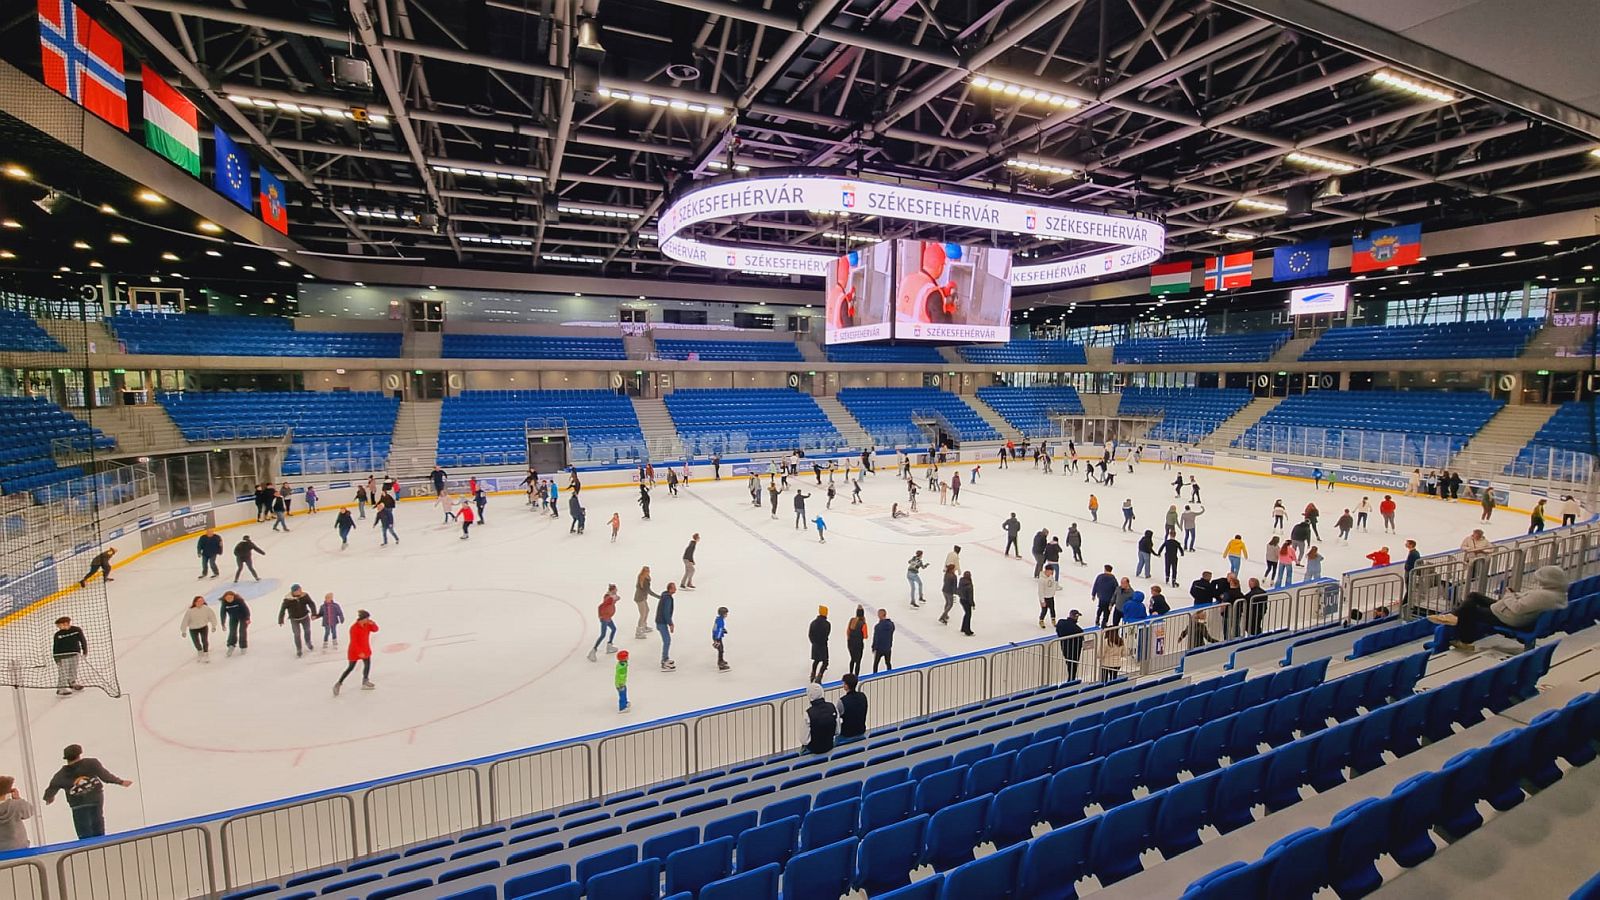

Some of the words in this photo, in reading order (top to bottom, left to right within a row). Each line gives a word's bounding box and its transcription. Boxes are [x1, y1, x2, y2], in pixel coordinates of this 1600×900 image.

[679, 183, 804, 222] SZÉKESFEHÉRVÁR
[868, 191, 1000, 224] SZÉKESFEHÉRVÁR
[1045, 214, 1148, 242] SZÉKESFEHÉRVÁR
[744, 253, 829, 272] SZÉKESFEHÉRV
[926, 327, 996, 339] SZÉKESFEHÉRVÁR
